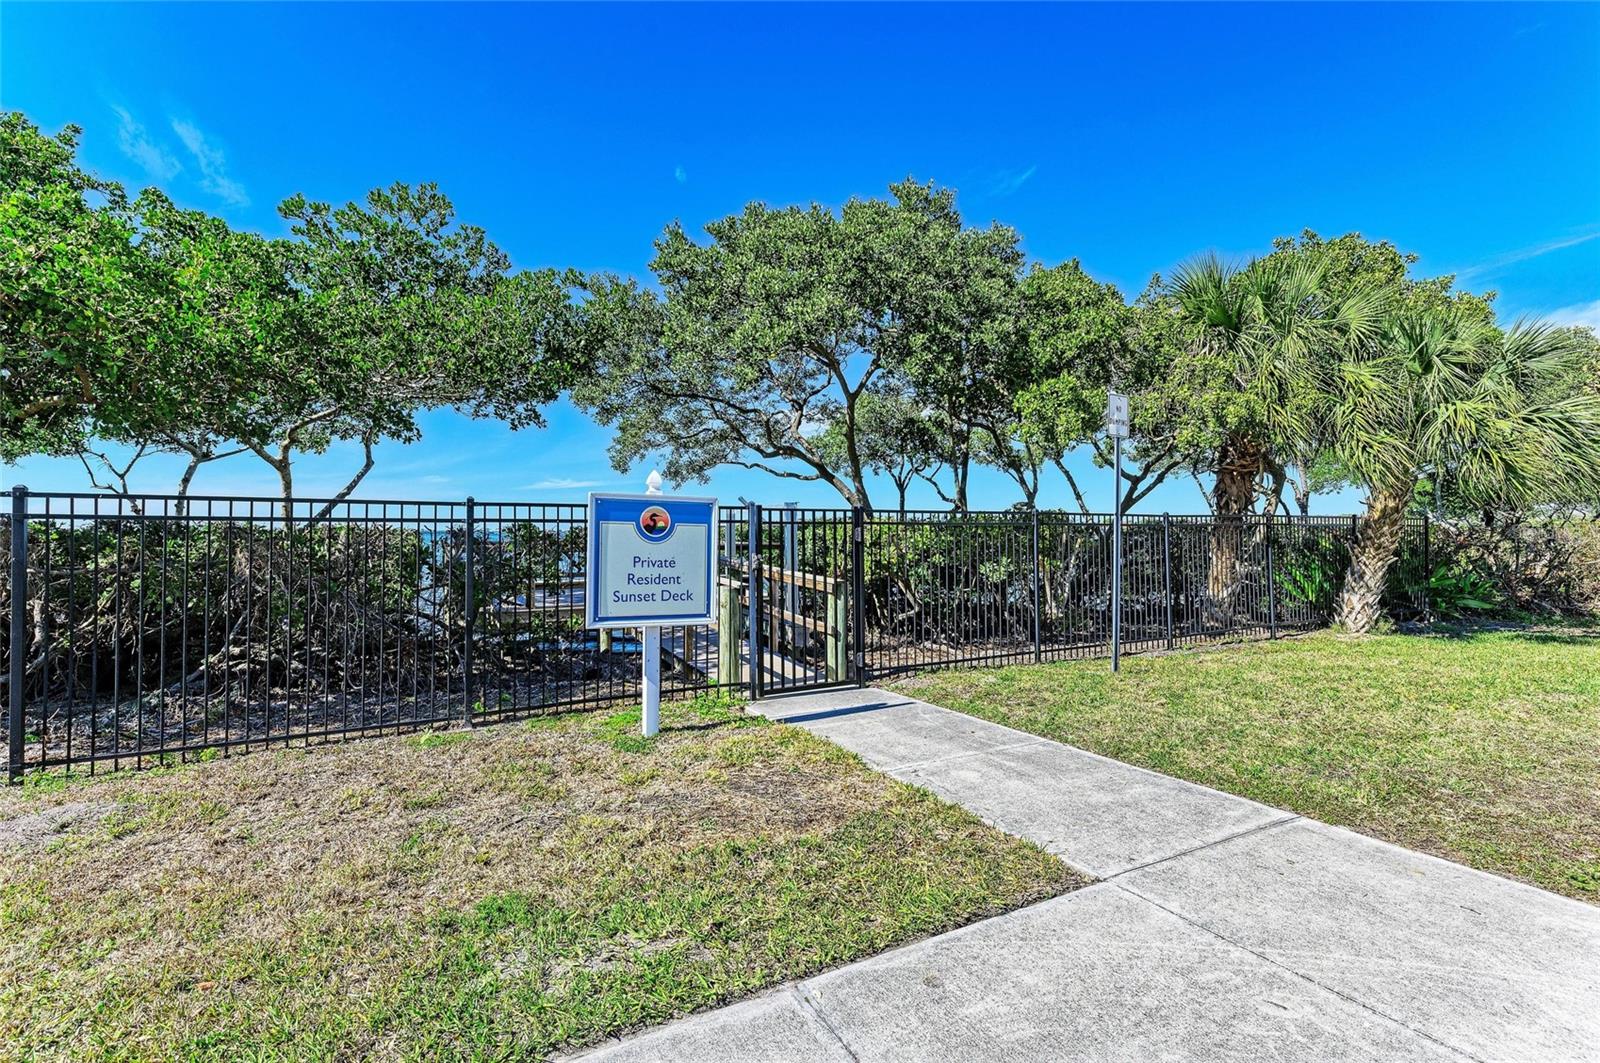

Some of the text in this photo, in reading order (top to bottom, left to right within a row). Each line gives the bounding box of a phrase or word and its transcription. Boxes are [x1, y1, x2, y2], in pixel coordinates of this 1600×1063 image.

[633, 556, 676, 568] Private
[627, 573, 681, 585] Resident
[613, 589, 694, 603] Sunset Deck
